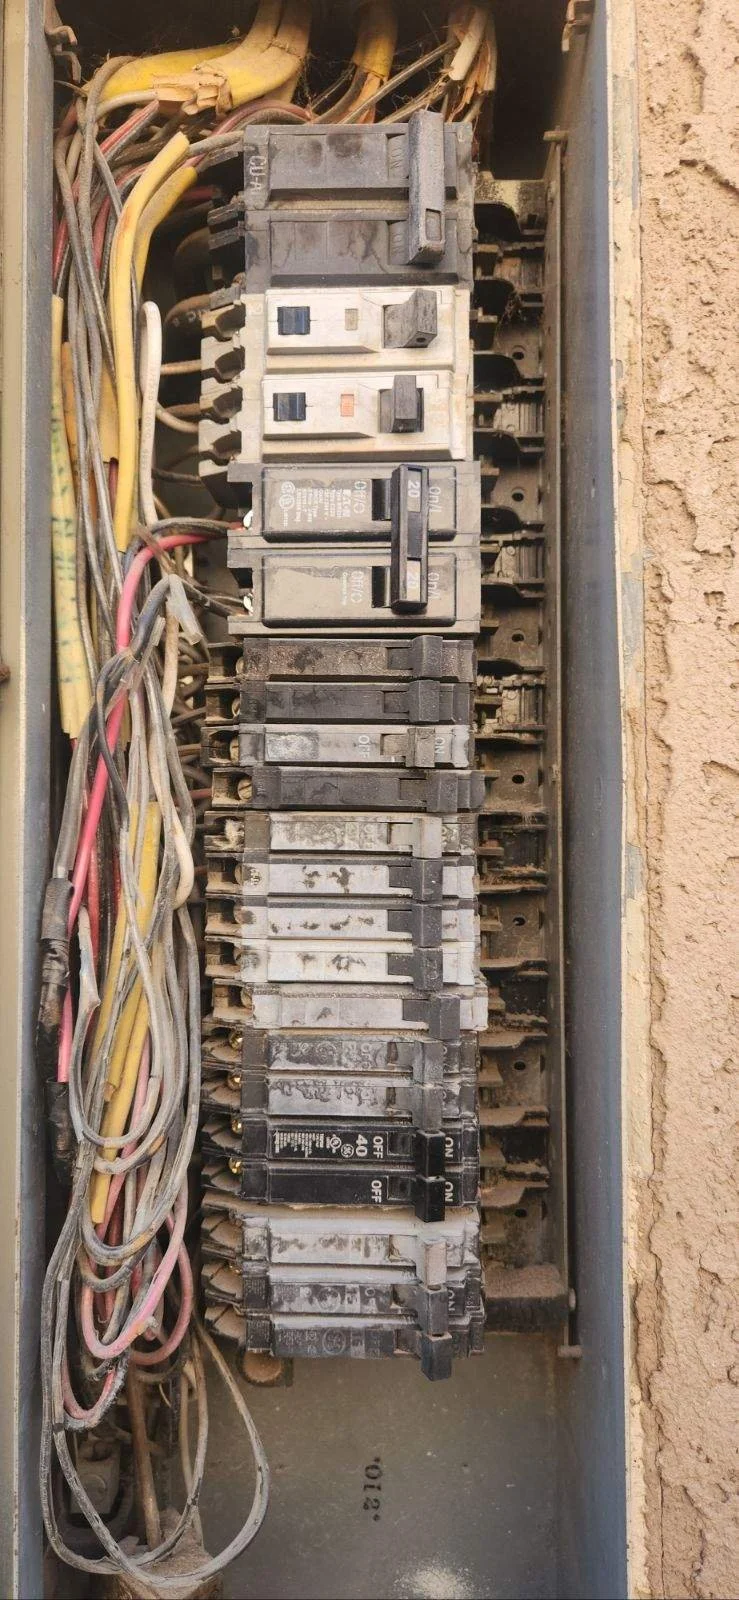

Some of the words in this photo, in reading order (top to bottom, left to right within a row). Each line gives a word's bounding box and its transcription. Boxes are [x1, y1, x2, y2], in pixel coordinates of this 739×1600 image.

[409, 480, 420, 498] 20
[409, 571, 419, 590] 20
[358, 735, 370, 758] OFF
[434, 736, 446, 755] ON
[355, 1134, 367, 1156] 40
[372, 1136, 383, 1158] OFF
[444, 1136, 454, 1158] ON
[371, 1180, 382, 1203] OFF
[444, 1181, 454, 1203] ON
